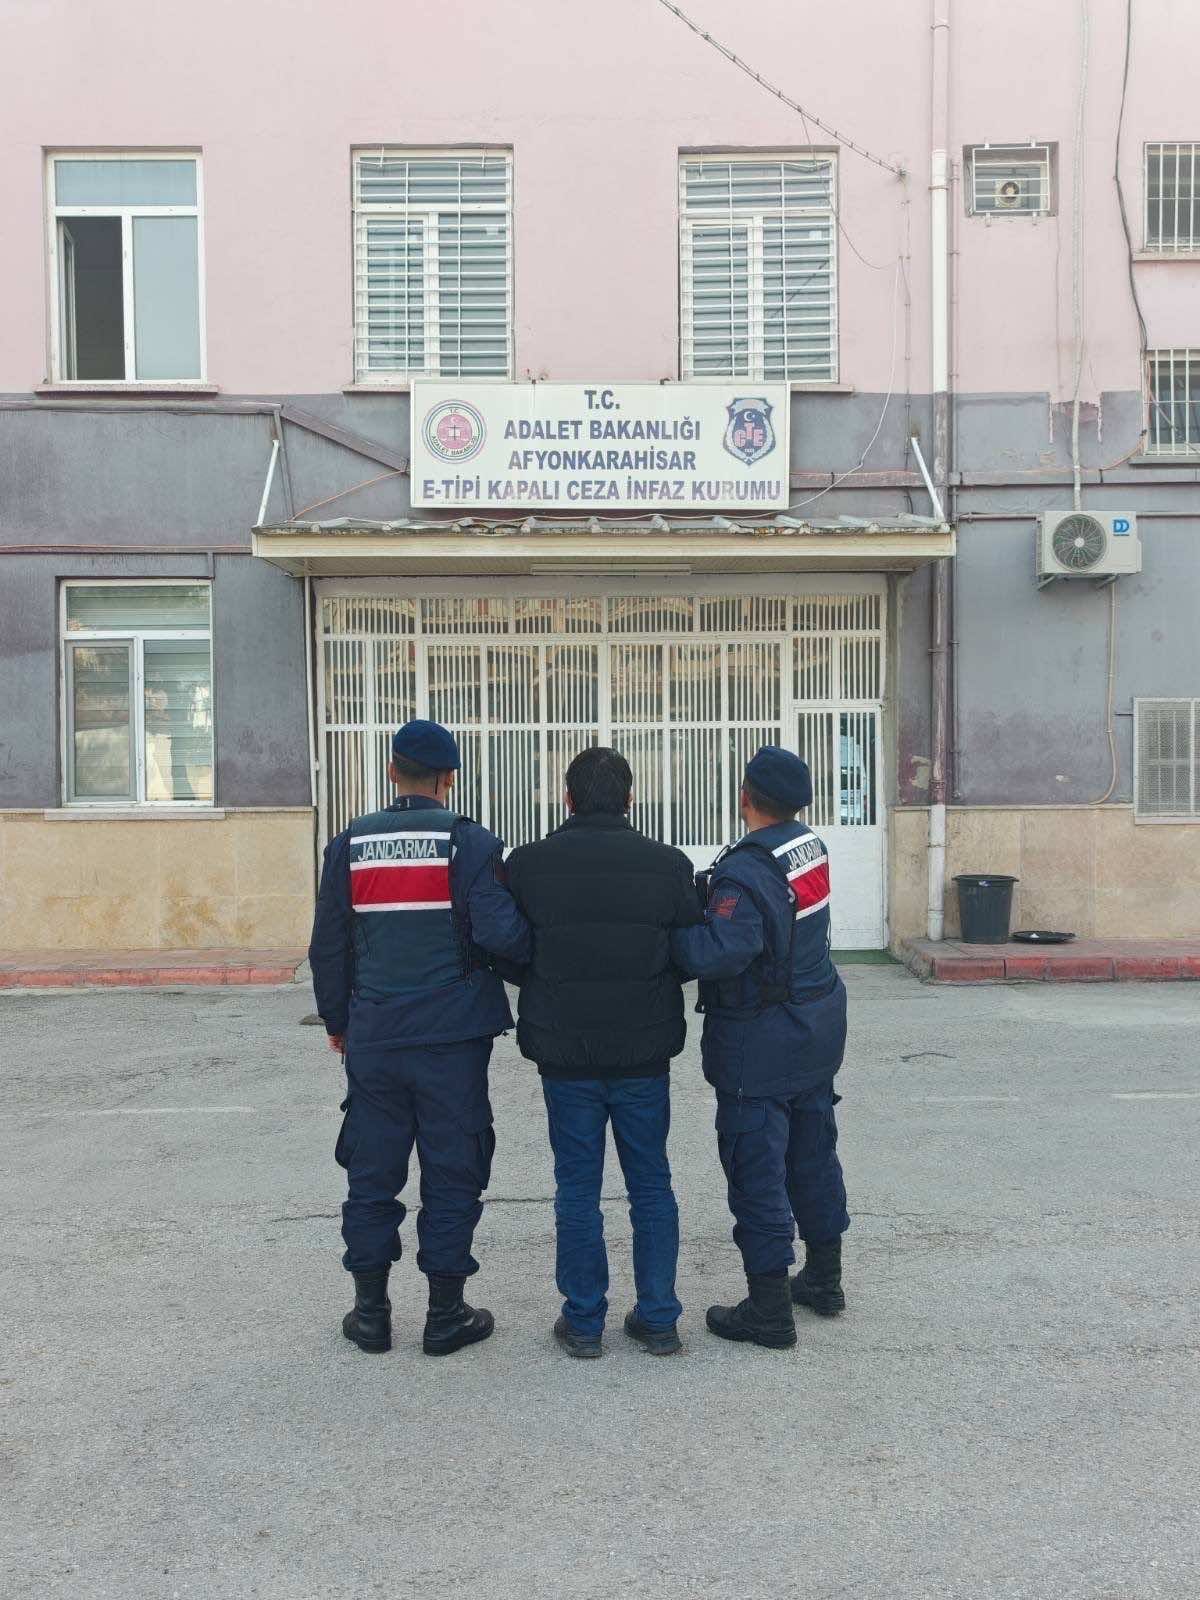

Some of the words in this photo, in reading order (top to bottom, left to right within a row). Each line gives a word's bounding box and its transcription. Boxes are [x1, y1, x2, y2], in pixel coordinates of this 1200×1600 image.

[584, 390, 620, 409] T.C.
[504, 420, 582, 439] ADALET
[590, 416, 700, 440] BAKANLIĞI
[508, 446, 696, 470] AFYONKARAHİSAR
[422, 475, 480, 499] E-TİPİ
[487, 480, 559, 500] KAPALI
[566, 480, 620, 500] CEZA
[626, 476, 685, 500] İNFAZ
[692, 480, 780, 500] KURUMU
[357, 839, 438, 861] JANDARMA
